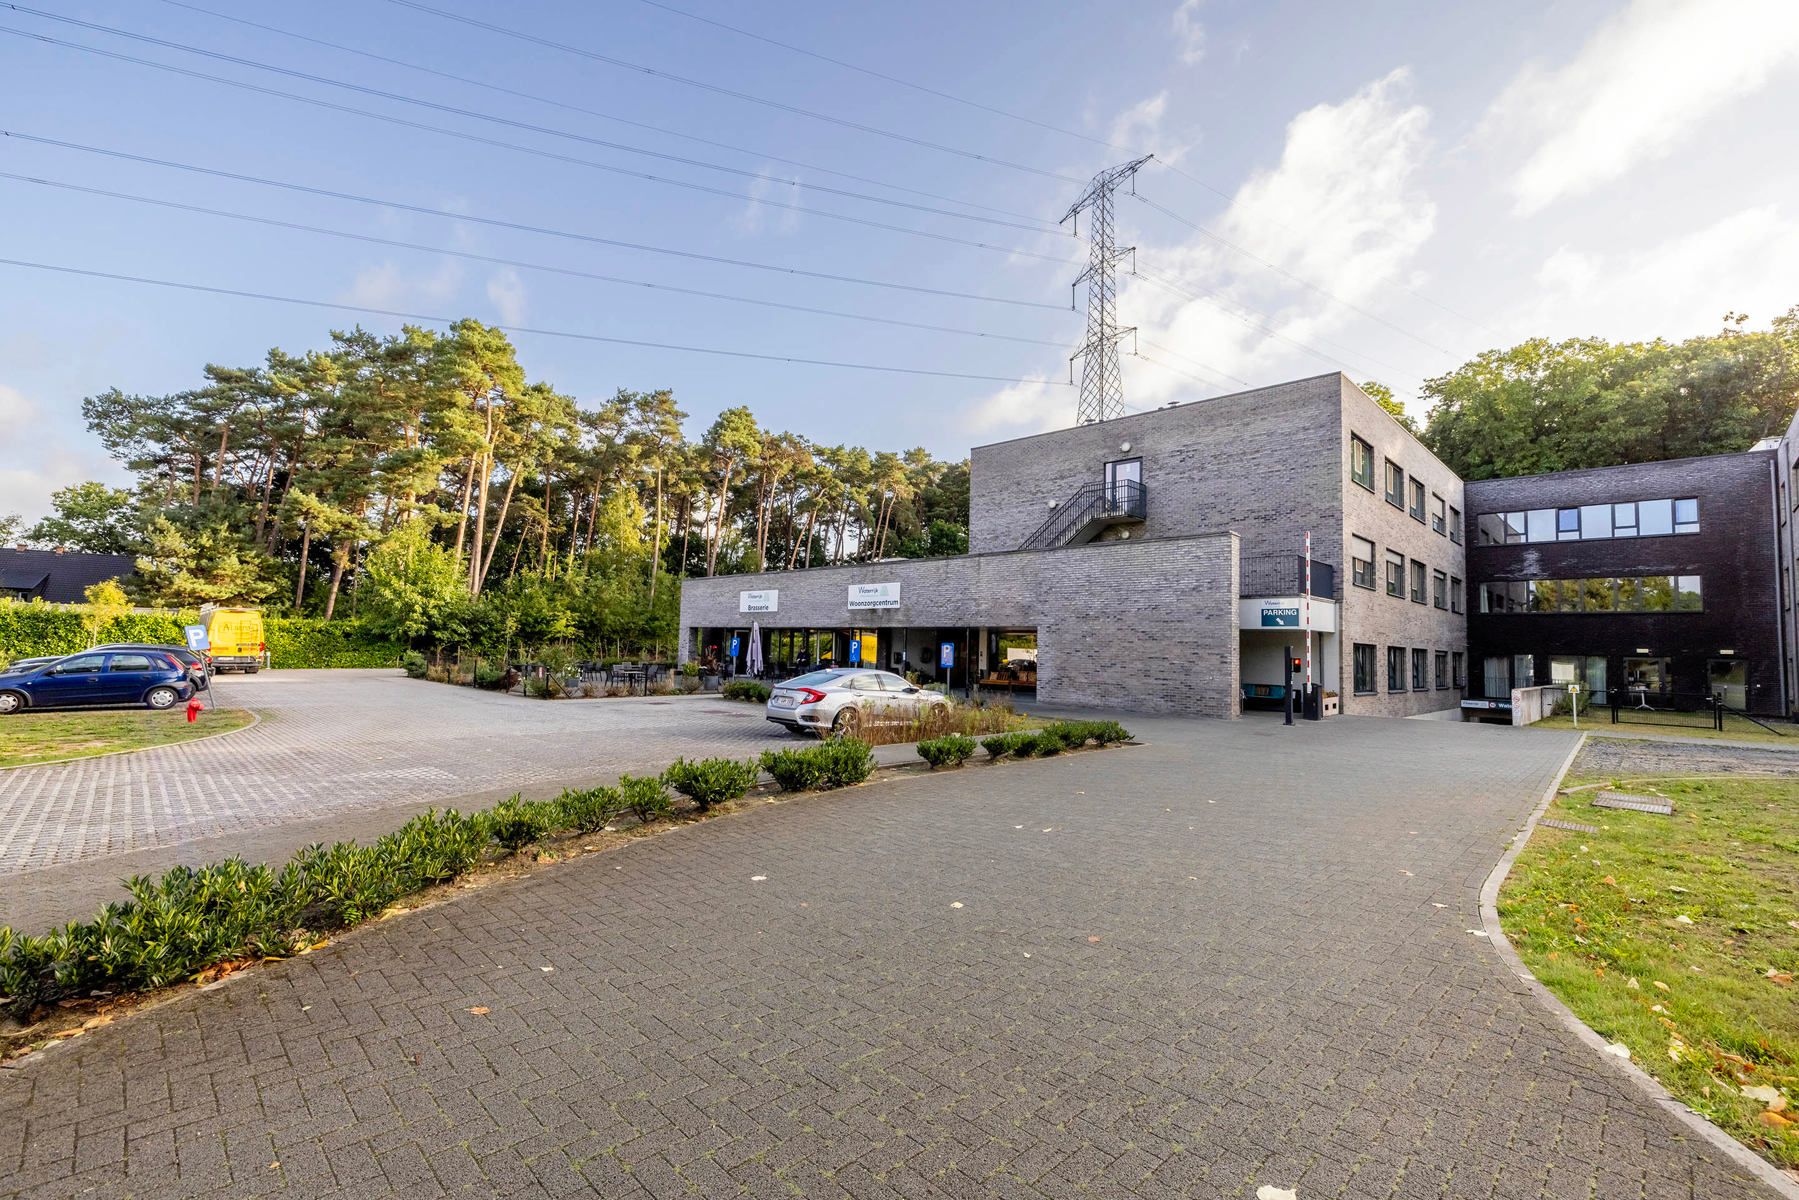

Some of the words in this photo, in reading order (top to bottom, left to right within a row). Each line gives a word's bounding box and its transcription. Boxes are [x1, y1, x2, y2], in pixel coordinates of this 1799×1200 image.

[189, 629, 204, 647] P
[732, 639, 738, 649] P
[851, 641, 858, 654] P
